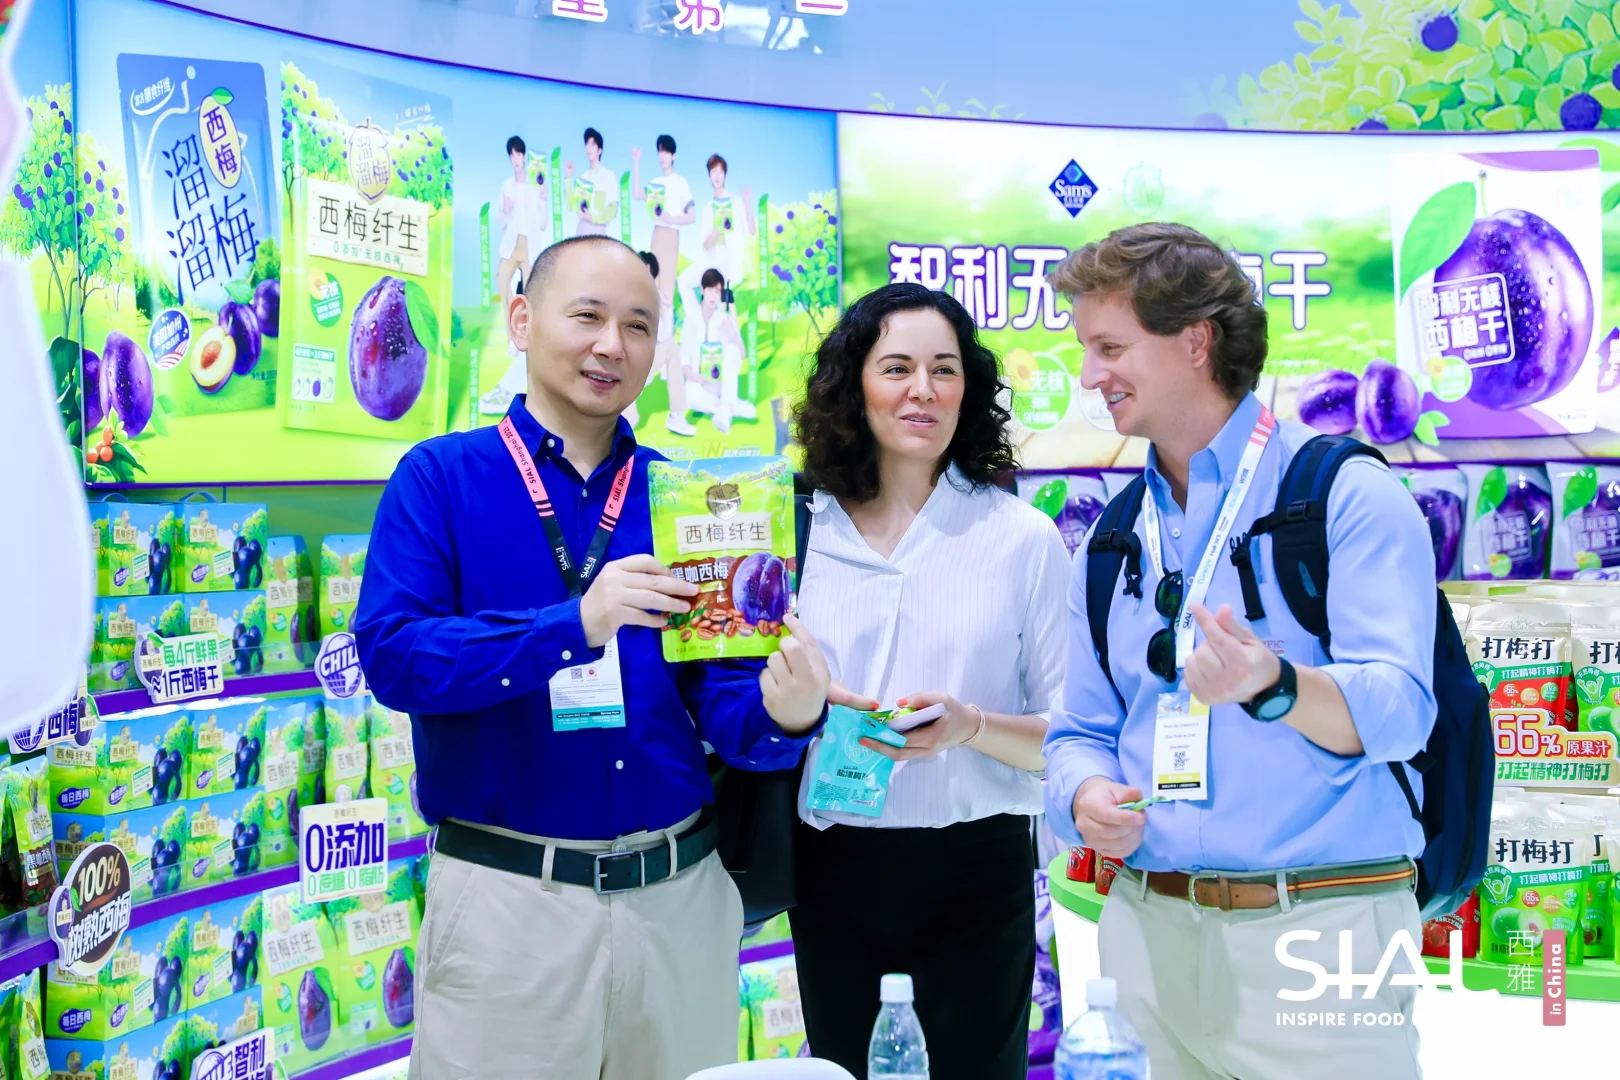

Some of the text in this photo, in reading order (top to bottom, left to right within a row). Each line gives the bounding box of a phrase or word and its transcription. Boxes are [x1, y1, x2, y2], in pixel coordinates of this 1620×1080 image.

[203, 106, 239, 181] 西梅
[1054, 178, 1093, 199] Sam's
[318, 195, 420, 251] 西梅纤生
[512, 437, 529, 467] Shanghai
[525, 467, 537, 484] SIAL
[612, 488, 623, 502] SIAL
[684, 522, 767, 545] 西梅纤生
[670, 561, 729, 583] 黑咖西梅
[163, 639, 219, 668] 每4斤鲜果
[320, 643, 358, 677] CHIL
[1481, 637, 1556, 660] 打梅打
[1589, 640, 1620, 665] 打
[1492, 713, 1563, 757] 66%
[56, 751, 93, 762] 西梅纤生
[1566, 740, 1612, 757] 原果汁
[1497, 762, 1611, 782] 打起精神打梅打
[305, 820, 385, 873] 0添加
[1495, 838, 1575, 864] 打梅打
[78, 852, 121, 907] 100%
[65, 891, 131, 968] 树熟西梅
[352, 909, 408, 942] 西梅纤生
[62, 1010, 92, 1028] 每日西梅
[235, 1034, 266, 1079] 智利
